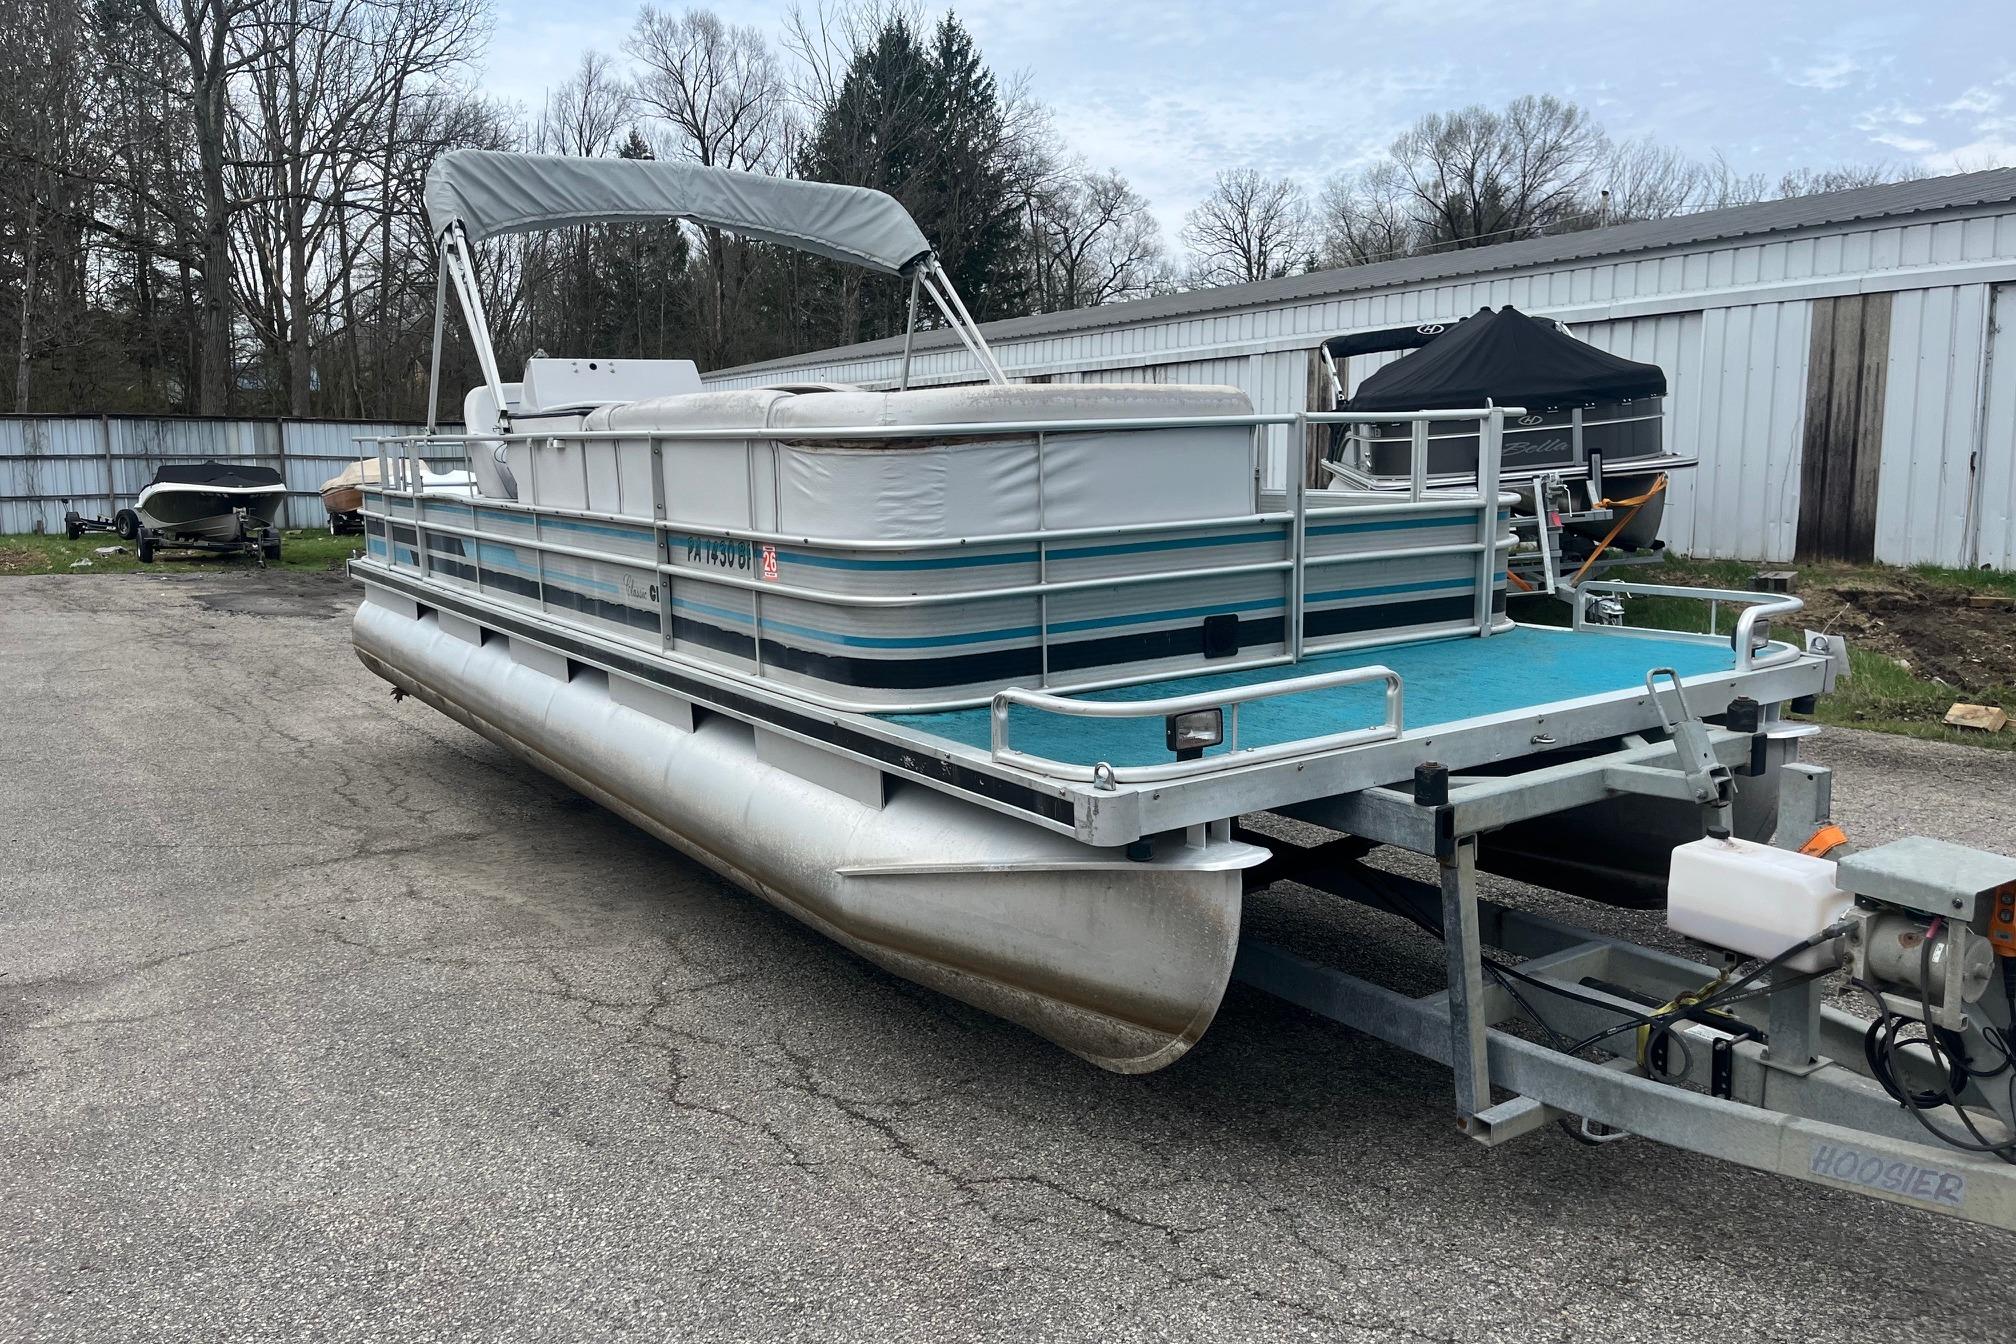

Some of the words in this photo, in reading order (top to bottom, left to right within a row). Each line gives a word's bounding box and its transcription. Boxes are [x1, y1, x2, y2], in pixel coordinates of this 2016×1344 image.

[1501, 438, 1569, 457] Bella
[687, 536, 702, 563] PA
[706, 539, 736, 568] 1430
[763, 551, 777, 572] 26
[1811, 1145, 1964, 1202] HOOSIER
